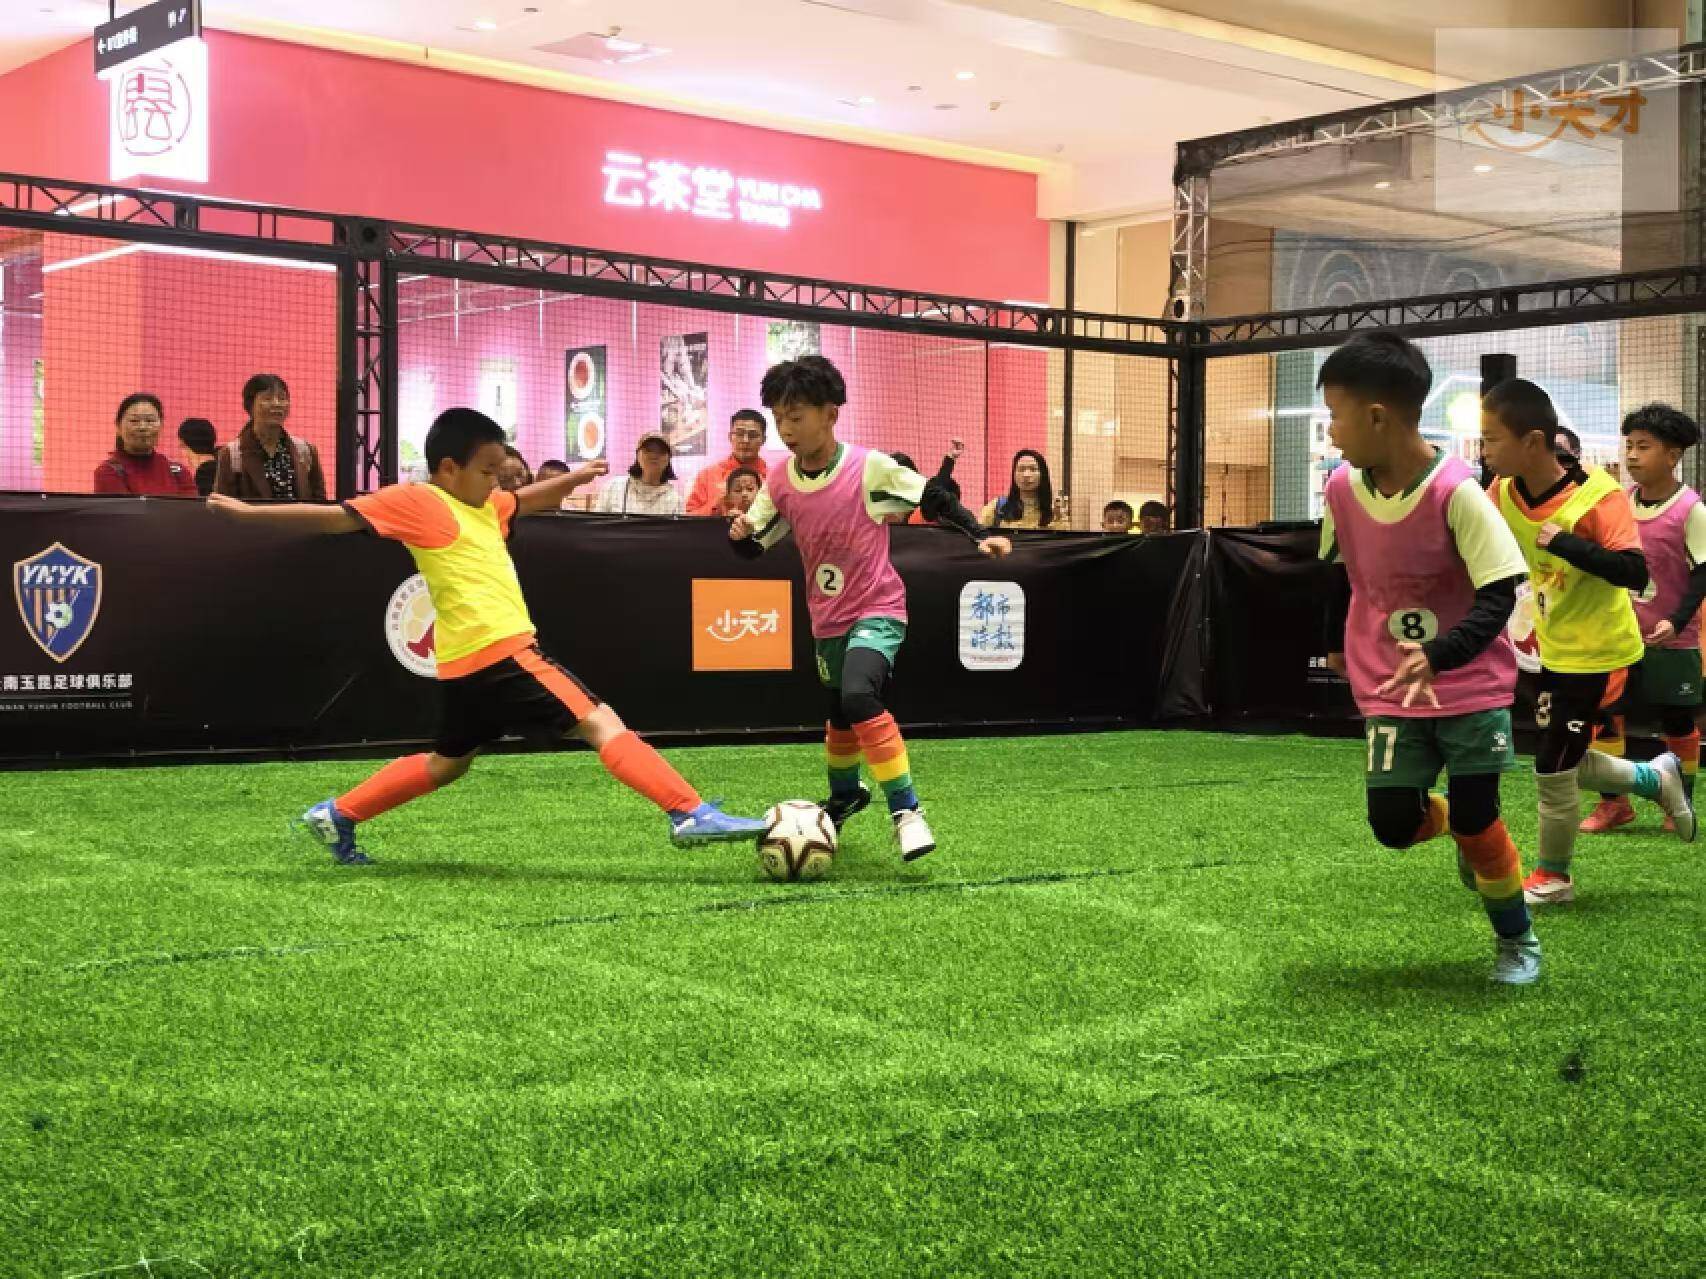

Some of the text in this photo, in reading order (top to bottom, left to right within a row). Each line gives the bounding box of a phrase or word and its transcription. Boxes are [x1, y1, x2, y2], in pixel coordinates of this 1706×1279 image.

[601, 151, 734, 221] 云茶堂
[23, 565, 93, 585] YNYK
[823, 569, 837, 591] 2
[706, 609, 779, 642] 小天才
[1401, 611, 1425, 639] 8
[0, 673, 133, 692] 南玉昆足球俱乐部
[1367, 726, 1398, 771] 17
